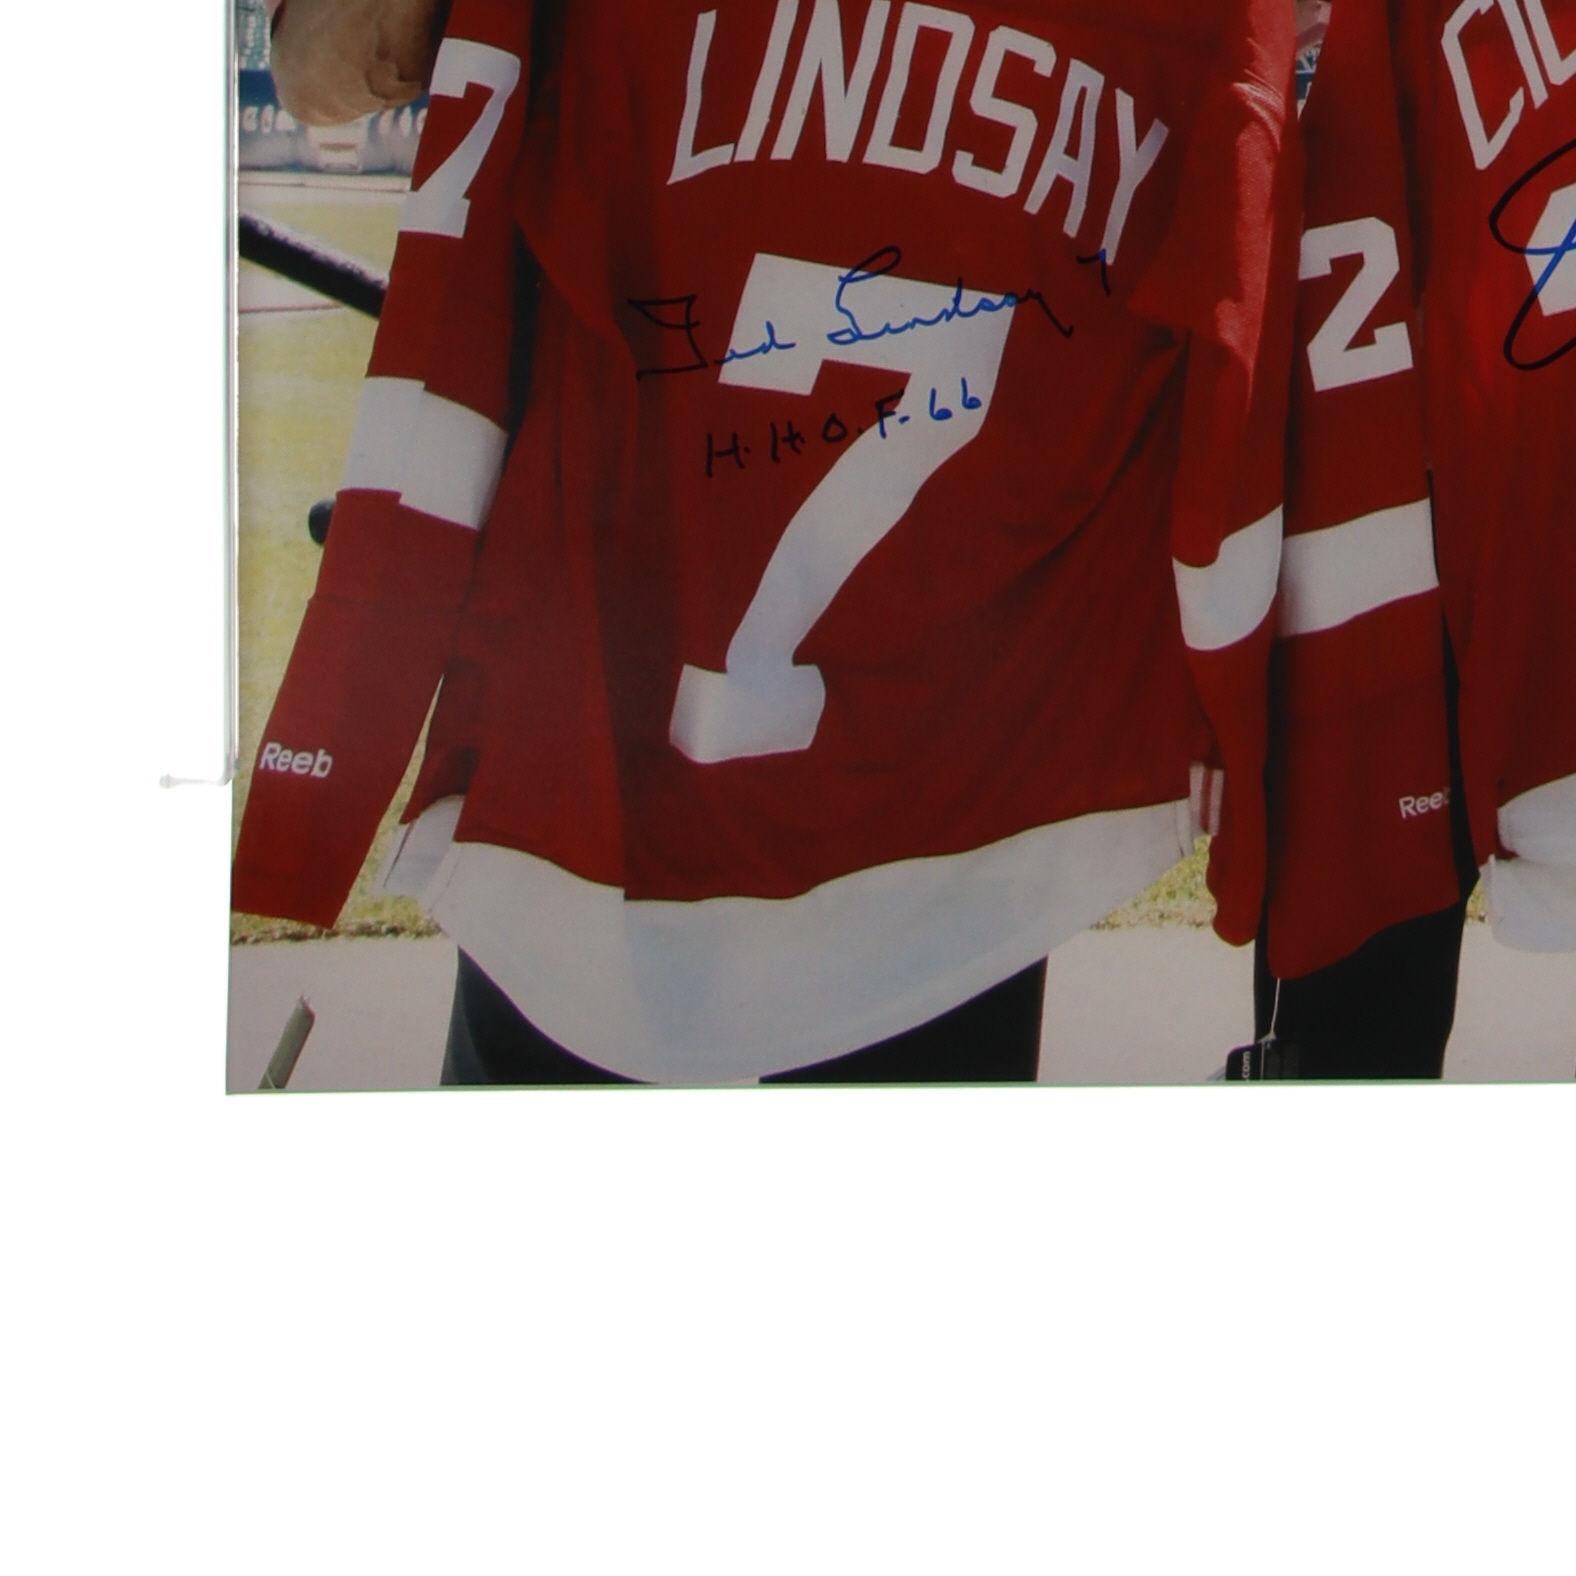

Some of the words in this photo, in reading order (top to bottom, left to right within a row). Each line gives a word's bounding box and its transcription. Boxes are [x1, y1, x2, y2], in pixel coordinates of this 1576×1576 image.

[398, 37, 521, 239] 7
[669, 252, 1016, 765] 7
[258, 741, 333, 779] Reeb
